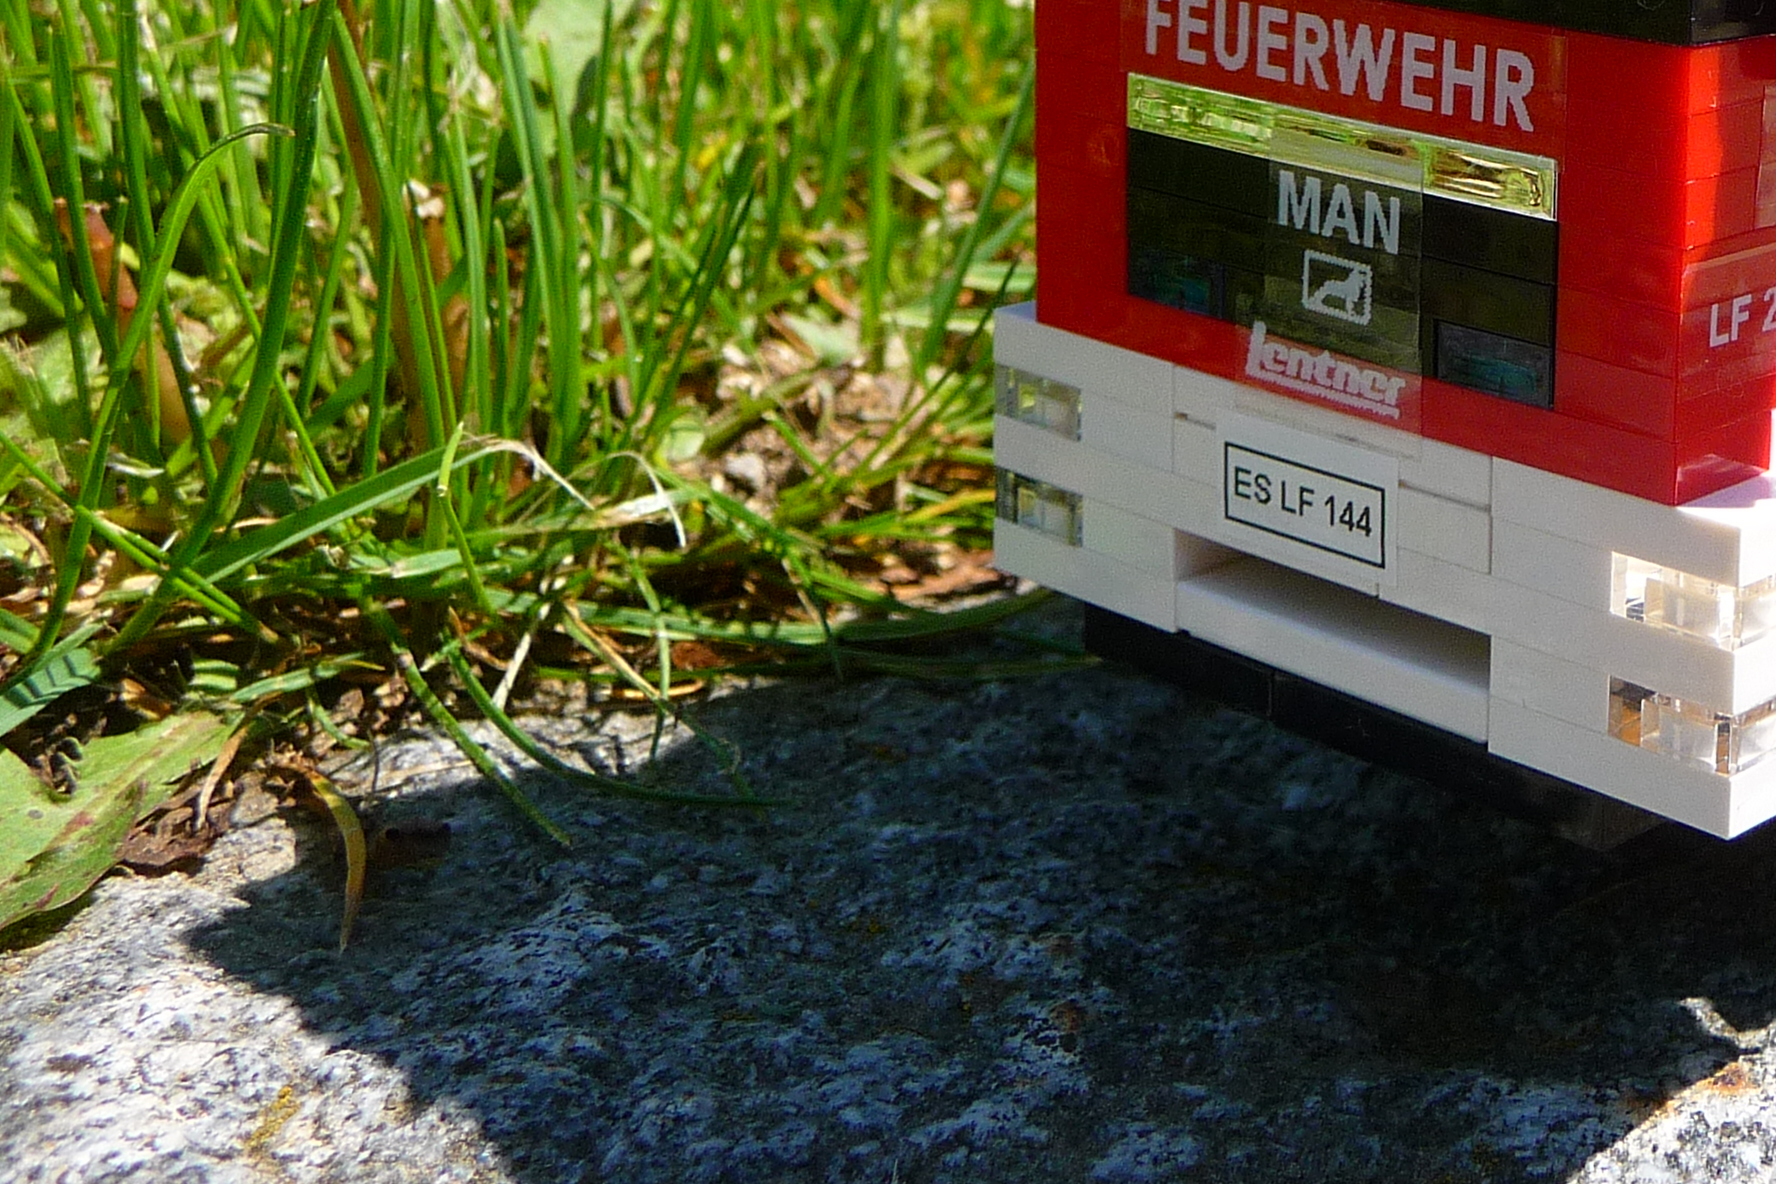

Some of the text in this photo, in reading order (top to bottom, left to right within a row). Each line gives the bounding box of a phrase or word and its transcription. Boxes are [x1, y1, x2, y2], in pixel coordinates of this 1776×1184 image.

[1278, 170, 1400, 255] MAN
[1708, 294, 1752, 348] LF
[1233, 466, 1373, 538] ES LF 144
